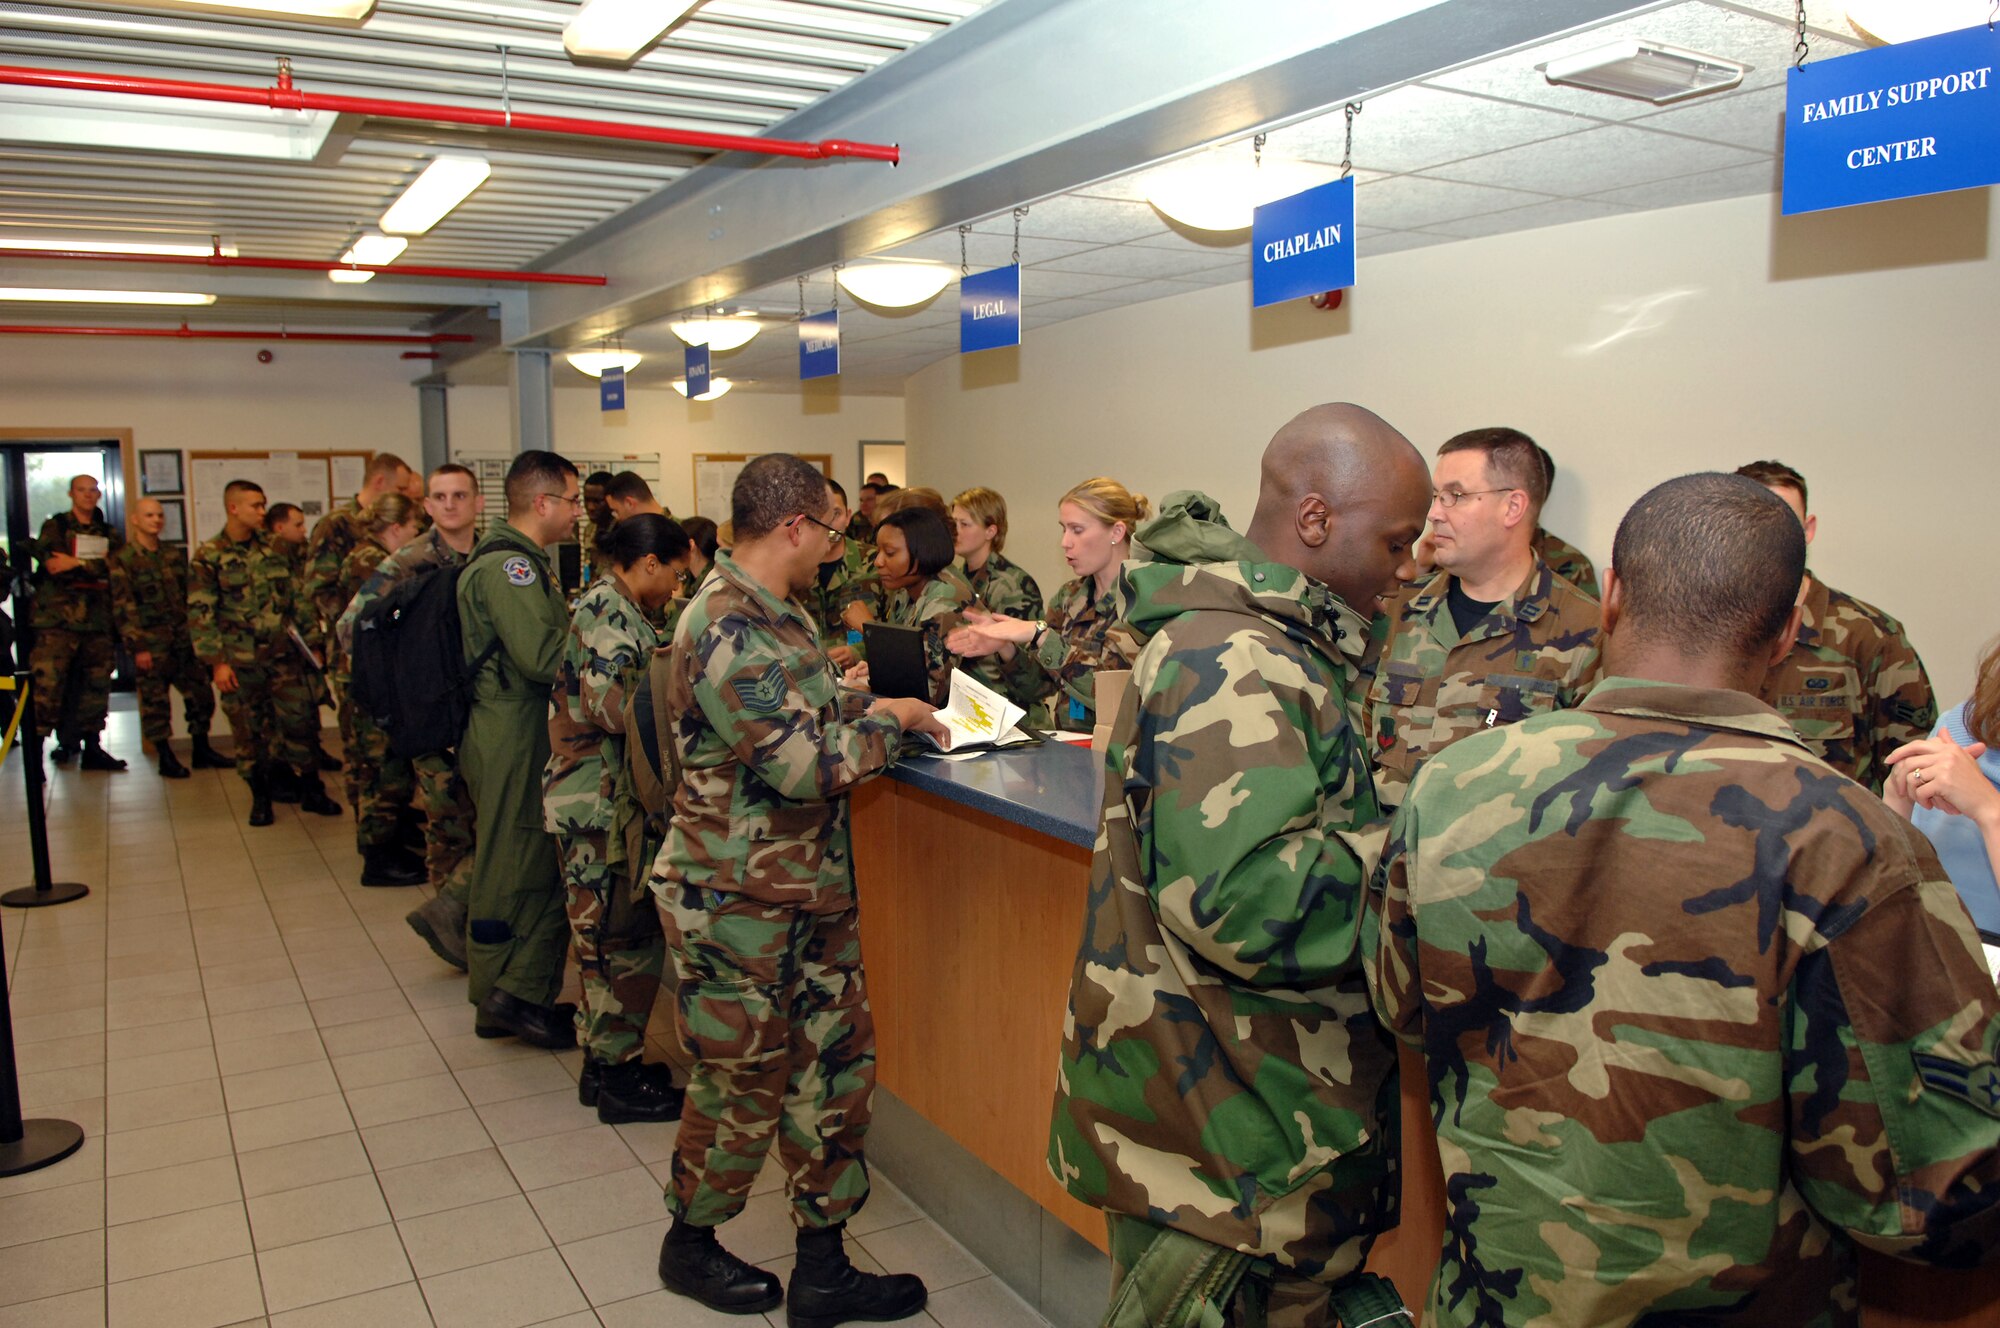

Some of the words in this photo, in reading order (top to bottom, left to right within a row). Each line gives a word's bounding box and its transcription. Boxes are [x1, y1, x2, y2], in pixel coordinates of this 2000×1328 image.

[1802, 89, 1883, 124] FAMILY
[1887, 67, 1992, 107] SUPPORT
[1846, 136, 1937, 170] CENTER
[1263, 223, 1342, 263] CHAPLAIN
[973, 299, 1007, 321] LEGAL
